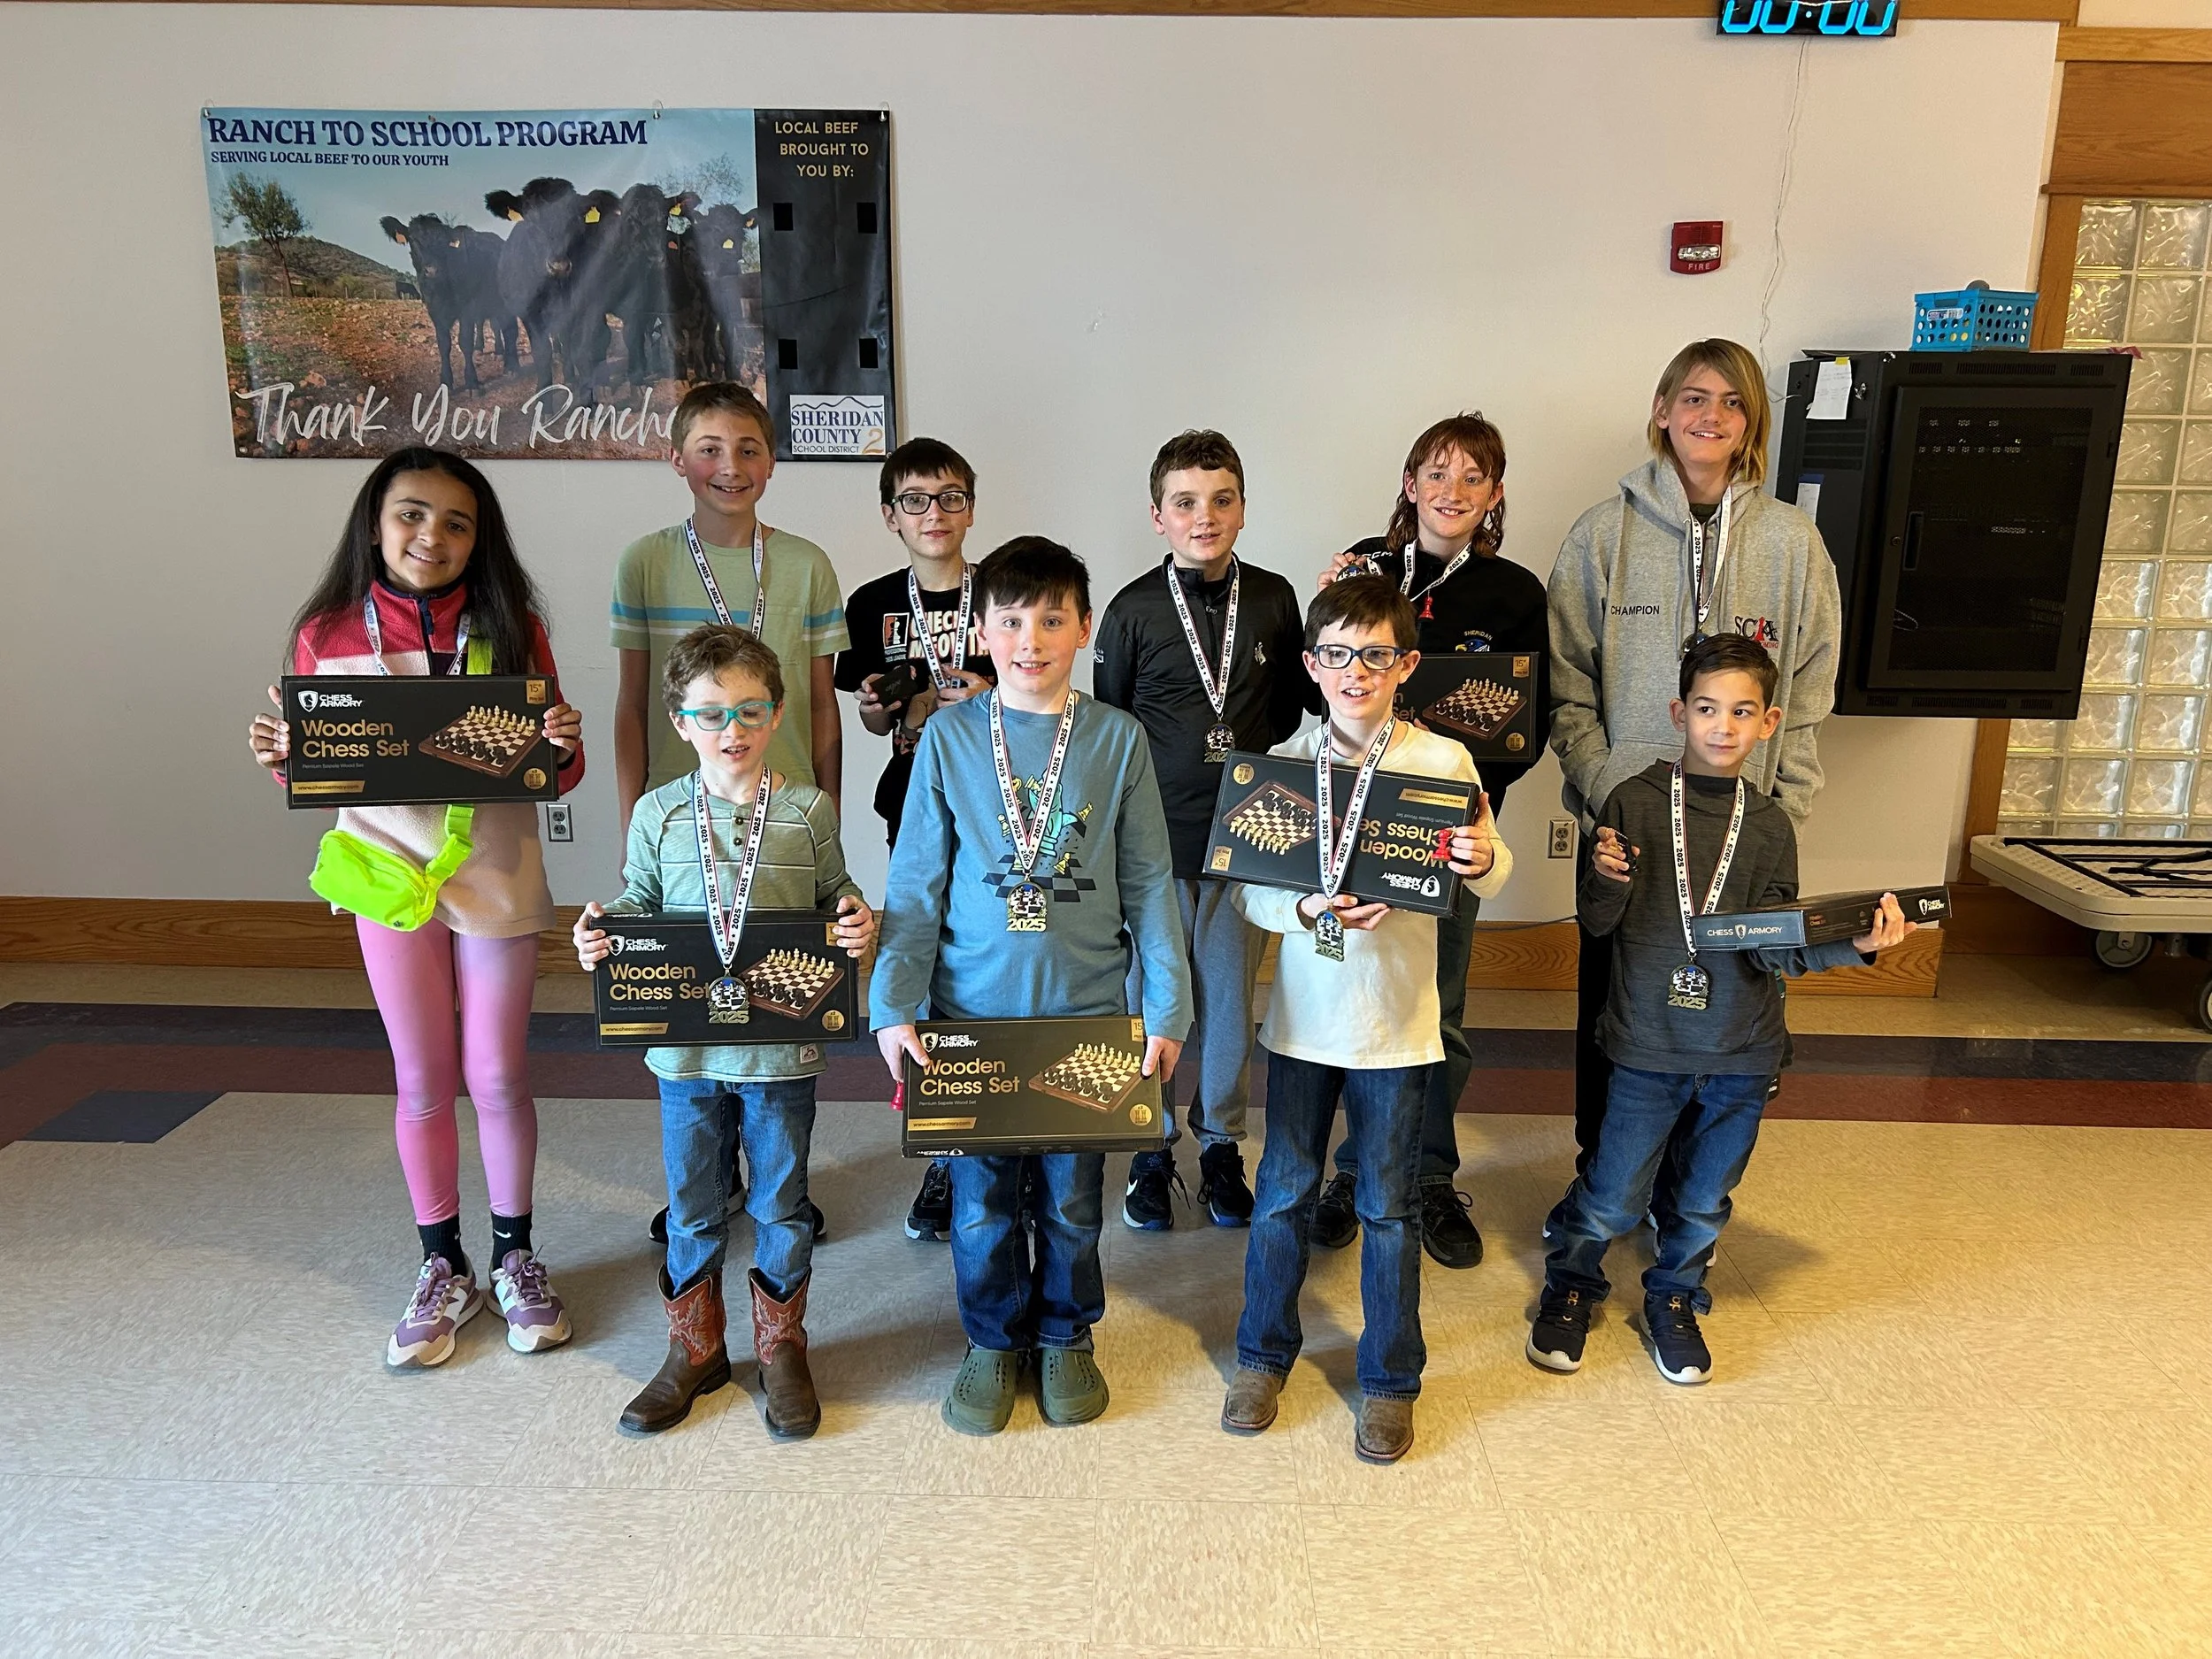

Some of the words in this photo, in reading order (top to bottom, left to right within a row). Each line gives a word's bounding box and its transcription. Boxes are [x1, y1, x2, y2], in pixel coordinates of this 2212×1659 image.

[208, 118, 316, 146] RANCH
[322, 119, 364, 146] TO
[372, 120, 491, 147] SCHOOL
[498, 119, 648, 146] PROGRAM
[776, 121, 819, 134] LOCAL
[825, 121, 858, 134] BEEF
[211, 150, 267, 164] SERVING
[270, 151, 312, 165] LOCAL
[314, 153, 349, 165] BEEF
[351, 153, 370, 165] TO
[373, 154, 401, 165] OUR
[404, 154, 449, 166] YOUTH
[780, 142, 846, 156] BROUGHT
[850, 142, 869, 156] TO
[796, 165, 827, 177] YOU
[833, 165, 854, 178] BY:
[234, 382, 389, 448] Thank
[411, 383, 500, 447] You
[791, 411, 884, 426] SHERIDAN
[792, 428, 862, 444] COUNTY
[862, 428, 884, 454] 2
[699, 562, 710, 579] 2025
[710, 587, 721, 604] 2025
[1610, 605, 1660, 616] CHAMPION
[1464, 630, 1494, 641] SHERIDAN
[918, 618, 927, 634] 2025
[926, 643, 934, 660] 2025
[933, 668, 944, 686] 2025
[1178, 603, 1188, 620] 2025
[1187, 627, 1198, 645] 2025
[1195, 653, 1206, 670] 2025
[1205, 679, 1215, 695] 2025
[301, 718, 394, 737] Wooden
[993, 729, 1002, 748] 2025
[1058, 728, 1068, 747] 2025
[302, 740, 370, 758] Chess
[376, 739, 410, 757] Set
[1203, 751, 1228, 763] 202
[996, 757, 1007, 778] 2025
[1051, 757, 1061, 777] 2025
[1365, 752, 1378, 768] 2025
[1003, 788, 1014, 809] 2025
[1042, 787, 1053, 808] 2025
[1356, 779, 1367, 799] 2025
[752, 817, 761, 837] 2025
[1011, 819, 1024, 840] 2025
[1033, 818, 1044, 840] 2025
[1346, 810, 1357, 831] 2025
[1359, 818, 1381, 837] Se
[1732, 814, 1740, 833] 2025
[700, 824, 709, 843] 2025
[745, 847, 756, 867] 2025
[1337, 842, 1348, 863] 2025
[1676, 848, 1685, 867] 2025
[1723, 842, 1733, 863] 2025
[704, 854, 713, 873] 2025
[1380, 872, 1423, 884] ARMORY
[1389, 879, 1422, 891] CHESS
[1713, 871, 1724, 892] 2025
[708, 884, 718, 903] 2025
[738, 878, 749, 898] 2025
[713, 915, 723, 935] 2025
[732, 908, 741, 930] 2025
[1005, 918, 1047, 933] 2025
[1707, 928, 1734, 937] CHESS
[1747, 926, 1783, 935] ARMORY
[609, 963, 696, 980] Wooden
[609, 983, 672, 1001] Chess
[1668, 994, 1707, 1010] 2025
[708, 1010, 750, 1025] 2025
[938, 1040, 979, 1048] ARMORY
[922, 1057, 1006, 1076] Wooden
[920, 1079, 983, 1096] Chess
[988, 1076, 1020, 1094] Set
